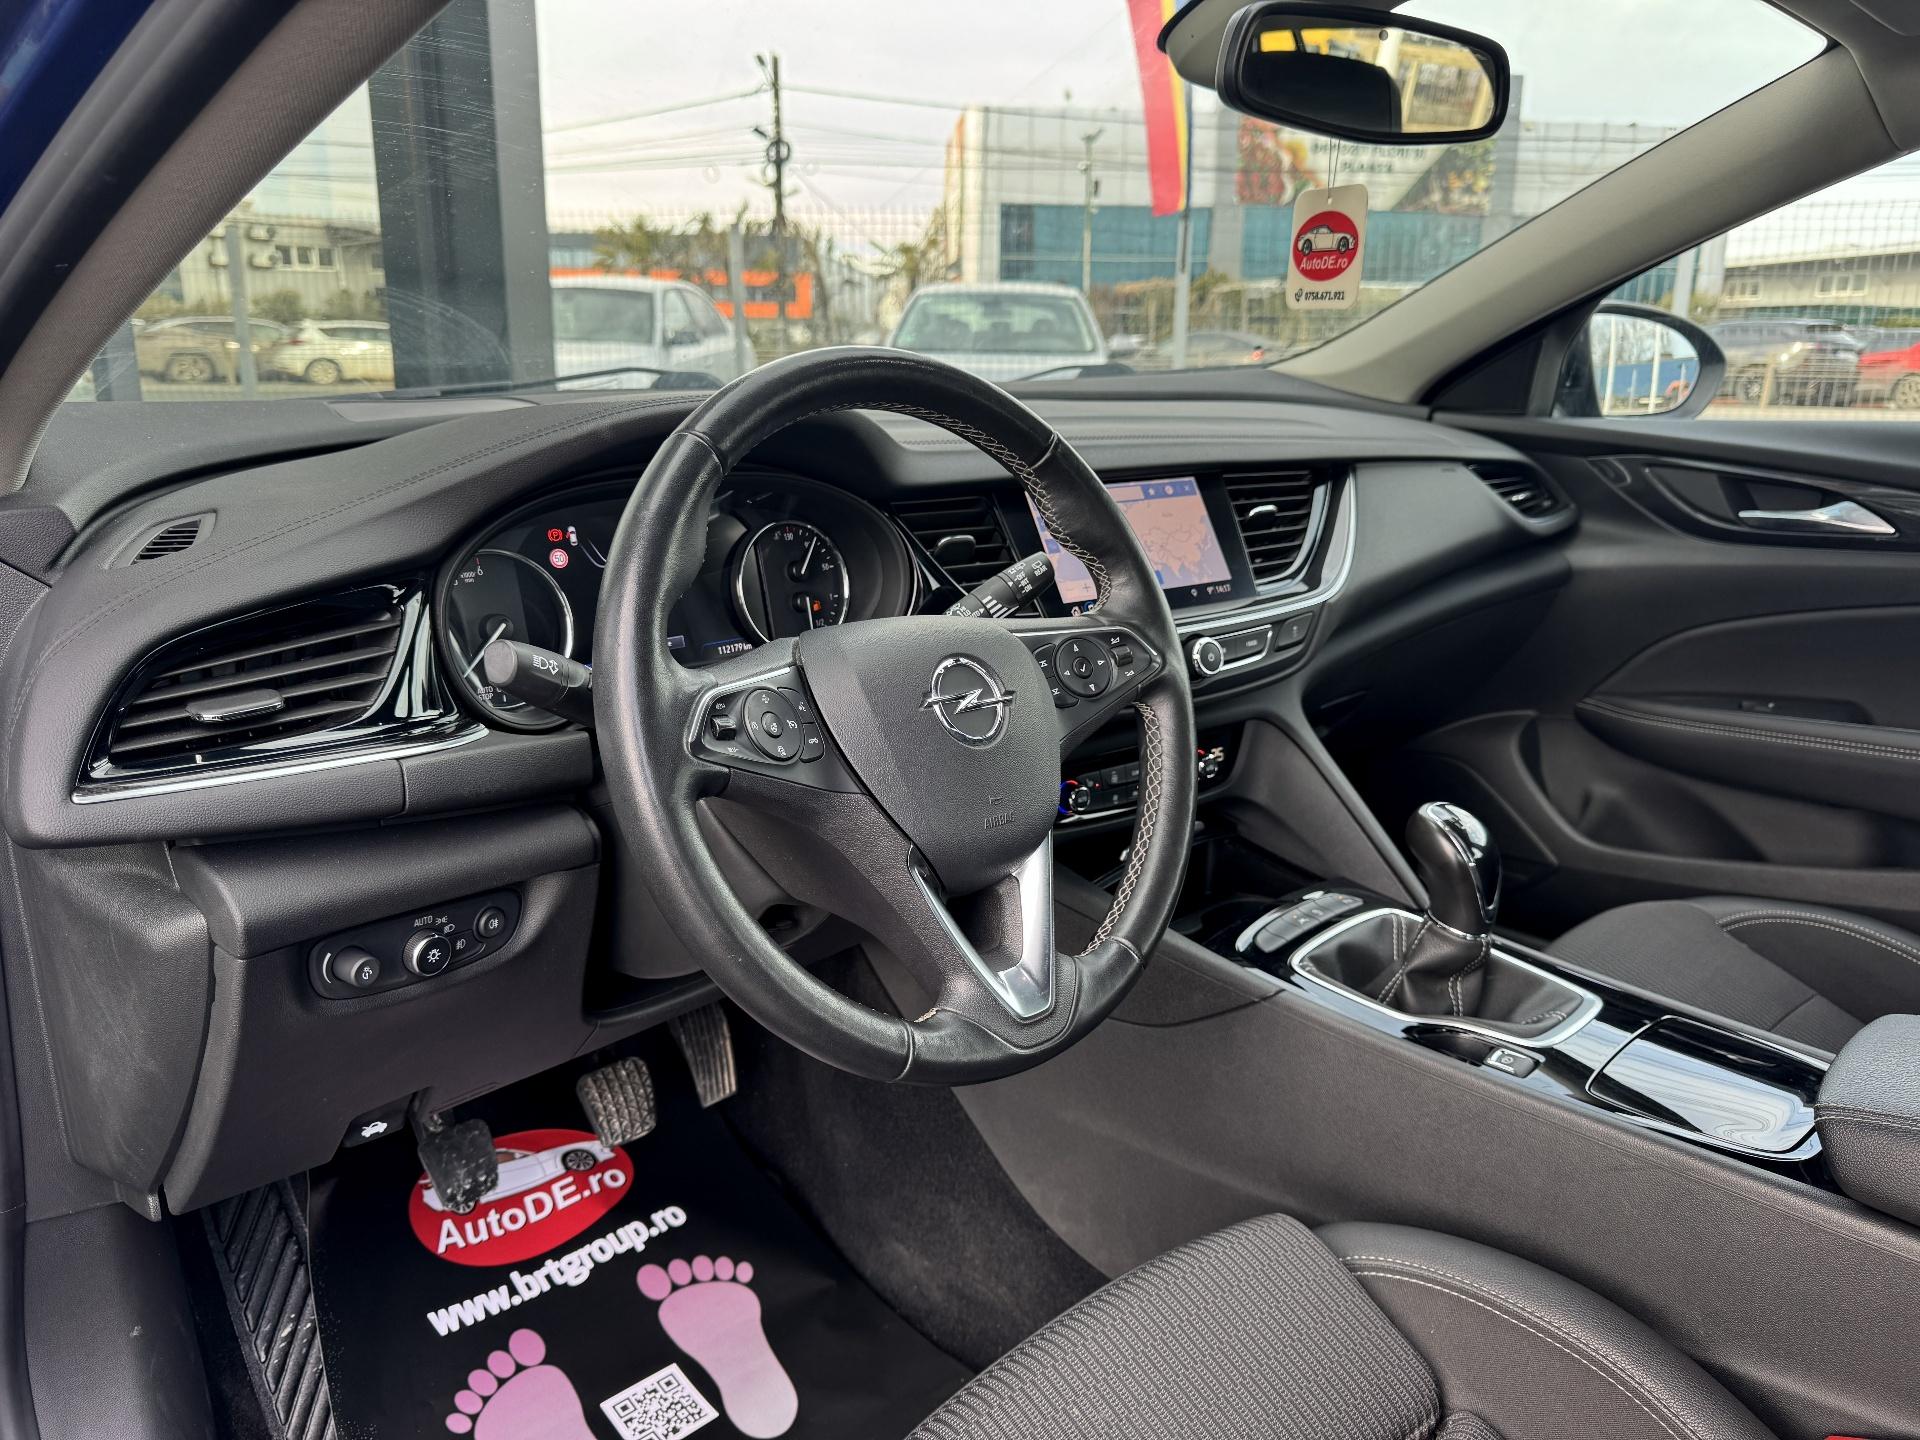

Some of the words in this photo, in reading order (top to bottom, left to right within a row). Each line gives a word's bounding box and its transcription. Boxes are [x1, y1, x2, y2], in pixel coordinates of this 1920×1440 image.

[1300, 255, 1349, 271] AutoDE.ro
[555, 555, 565, 563] 50
[477, 565, 484, 576] 6
[477, 686, 494, 695] AUTO
[479, 693, 494, 701] STOP
[414, 915, 433, 928] AUTO
[436, 1168, 627, 1254] AutoDE.ro
[426, 1205, 688, 1337] www.brtgroup.ro
